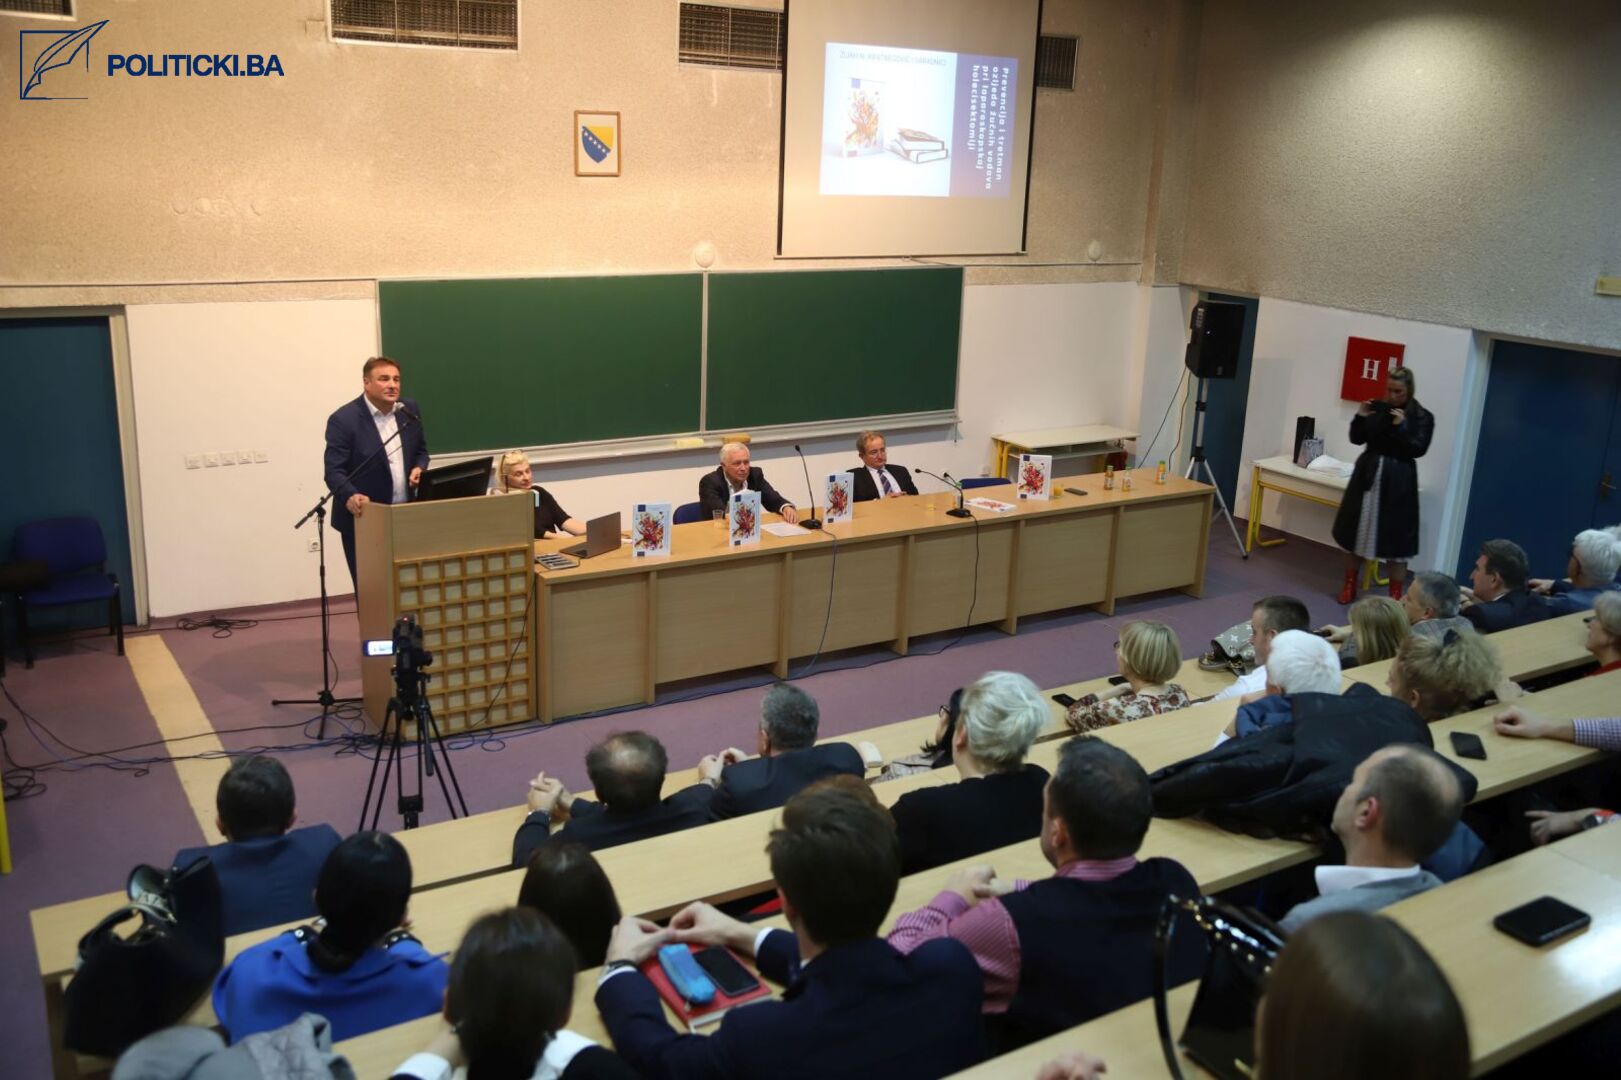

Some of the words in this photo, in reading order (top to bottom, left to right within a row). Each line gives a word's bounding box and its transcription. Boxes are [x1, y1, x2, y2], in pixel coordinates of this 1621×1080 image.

[982, 65, 990, 81] pri
[998, 67, 1010, 125] Prevencija
[995, 136, 1005, 181] tretman
[1361, 358, 1380, 381] H
